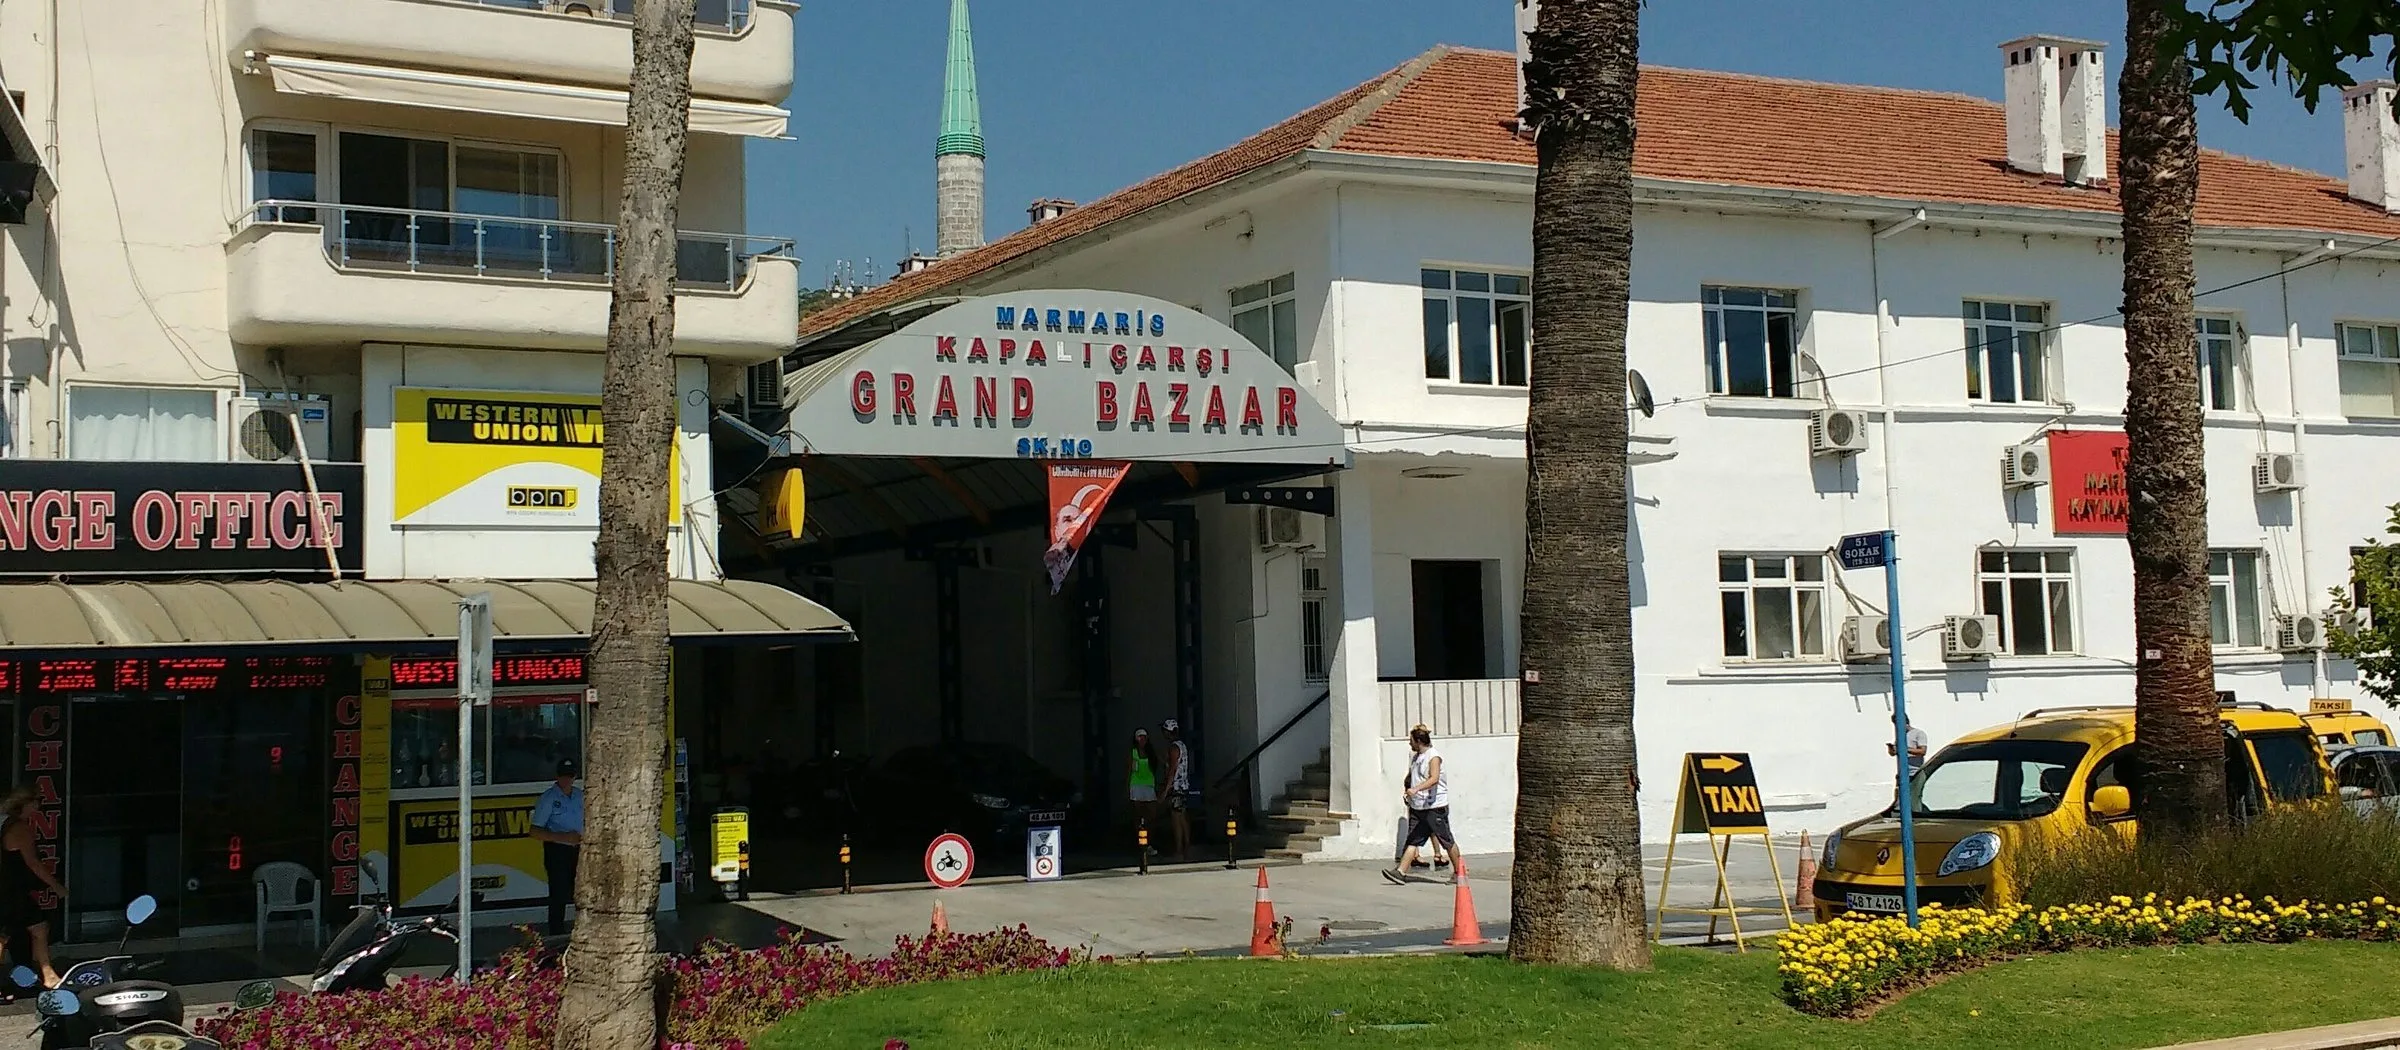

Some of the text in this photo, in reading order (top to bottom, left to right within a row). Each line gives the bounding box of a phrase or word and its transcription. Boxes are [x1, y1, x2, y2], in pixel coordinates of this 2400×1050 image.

[996, 306, 1164, 335] MARMARİS
[1109, 343, 1230, 375] ÇARŞI
[434, 403, 558, 423] WESTERN
[851, 370, 1299, 434] GRAND BAZAAR
[473, 423, 558, 442] UNION
[511, 488, 563, 507] bpn
[132, 490, 343, 550] OFFICE
[2068, 498, 2129, 522] KAYMA
[1845, 546, 1880, 559] SOKAK
[1855, 537, 1868, 547] 51
[392, 658, 582, 683] WESTN UNION
[331, 695, 362, 896] CHANGE
[1703, 786, 1761, 813] TAXI
[410, 811, 496, 828] WESTRN
[437, 824, 496, 839] UNON
[1853, 895, 1901, 910] 48 T 4126
